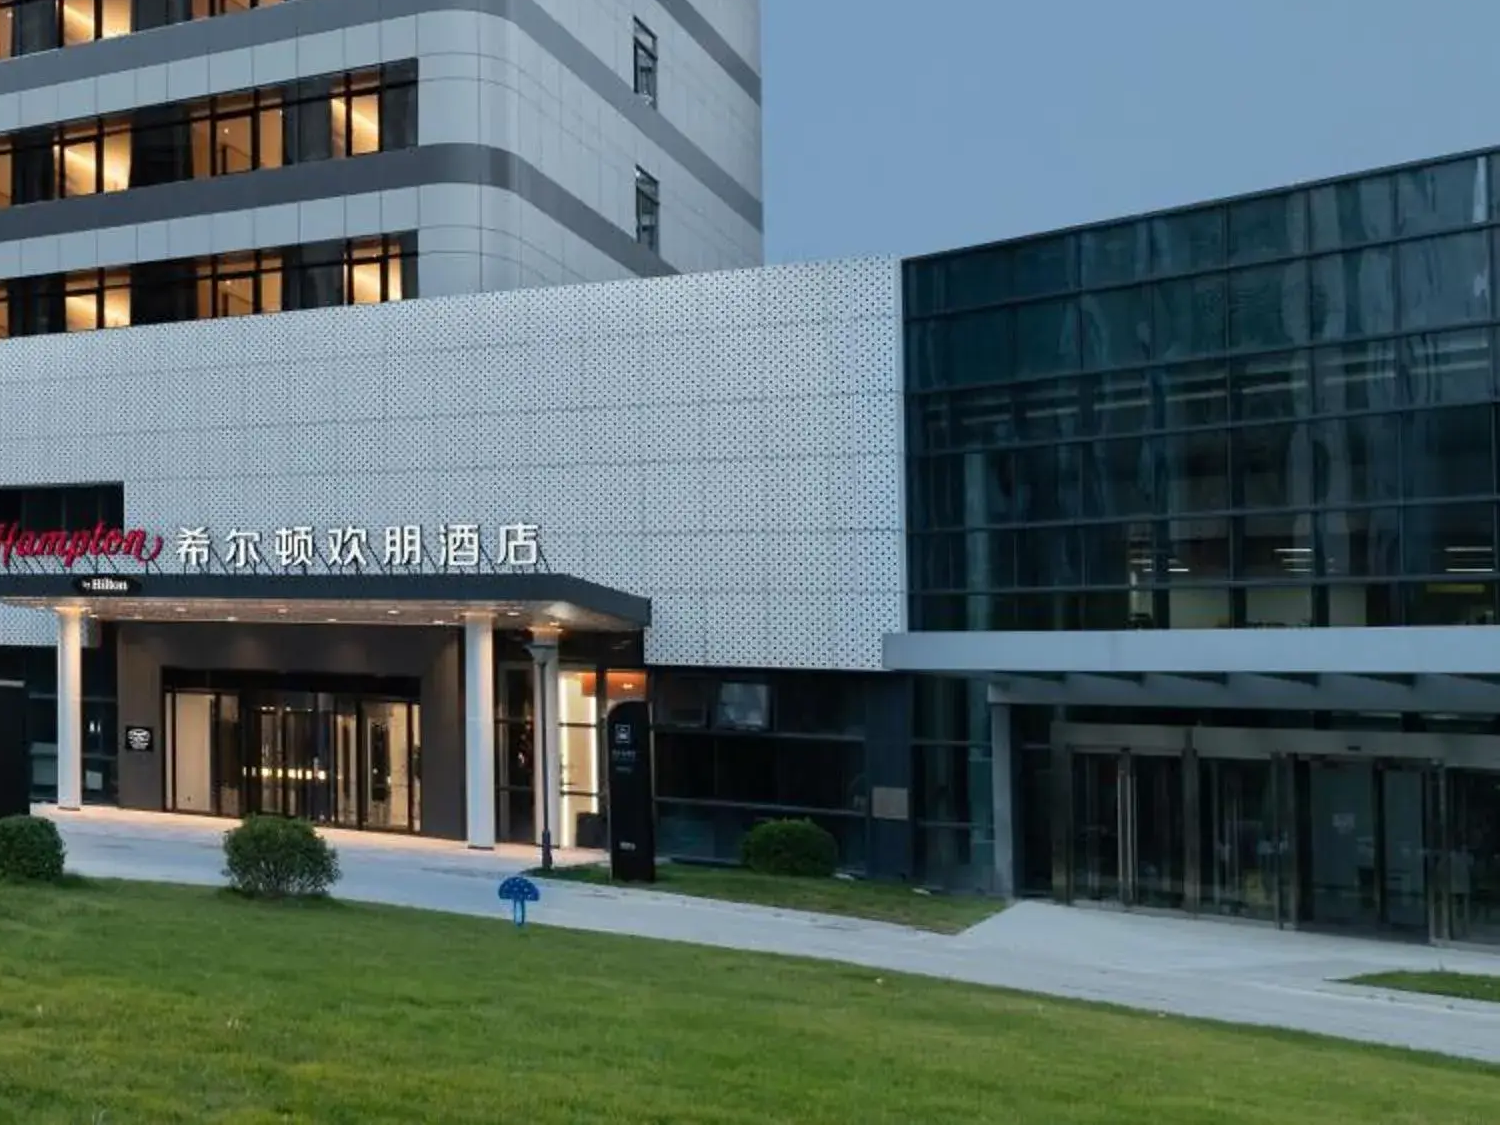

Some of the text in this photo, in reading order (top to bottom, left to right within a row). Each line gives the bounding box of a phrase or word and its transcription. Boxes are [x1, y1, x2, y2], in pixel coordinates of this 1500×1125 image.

[176, 523, 540, 567] 希尔顿欢朋酒店
[92, 577, 128, 591] Hilton
